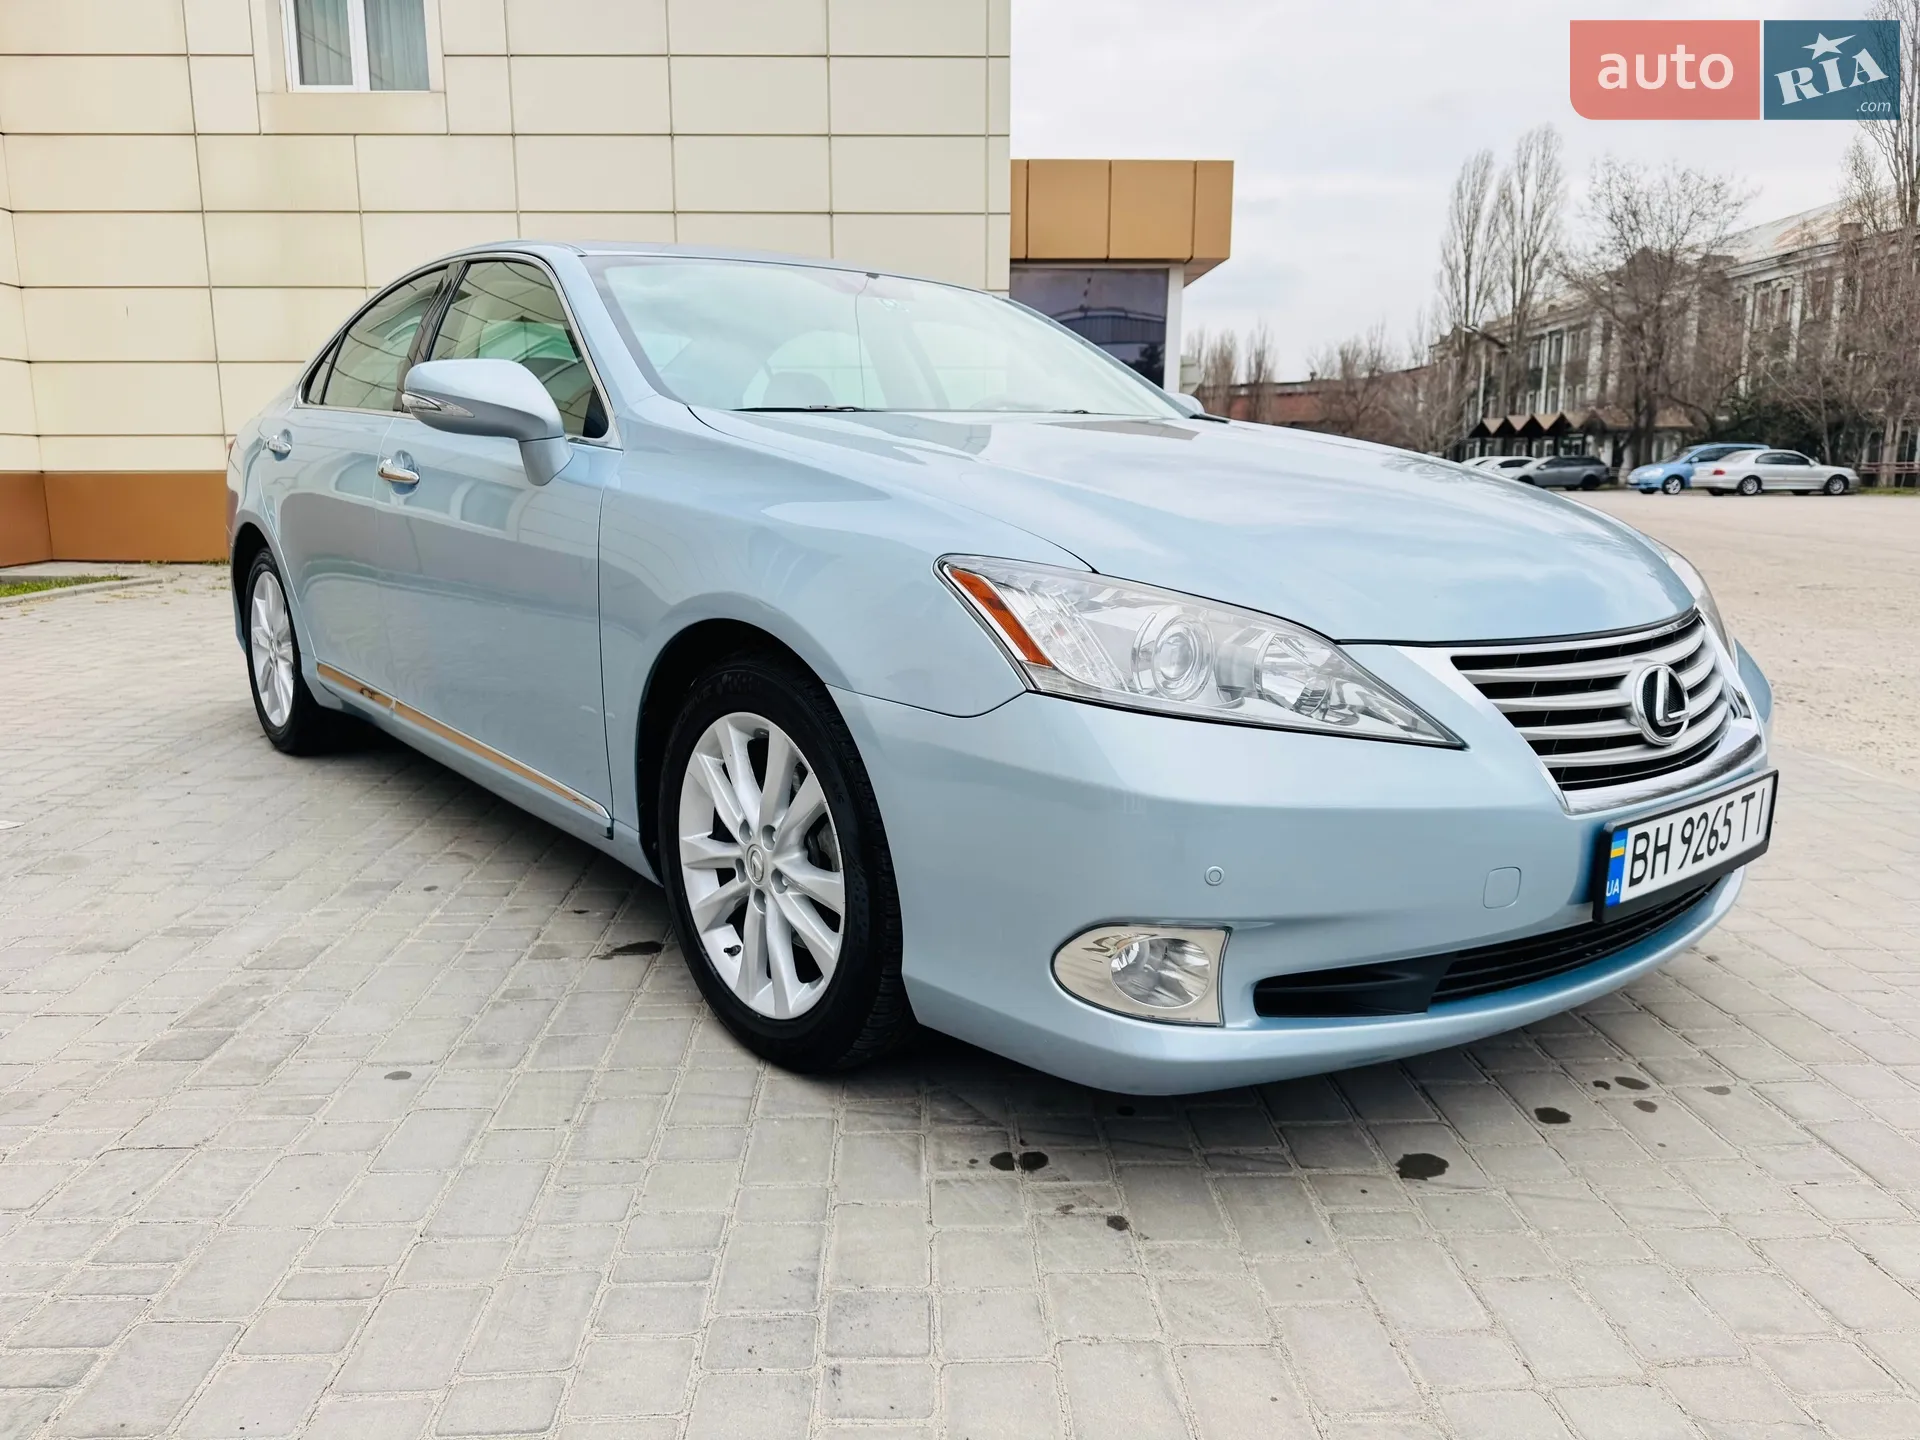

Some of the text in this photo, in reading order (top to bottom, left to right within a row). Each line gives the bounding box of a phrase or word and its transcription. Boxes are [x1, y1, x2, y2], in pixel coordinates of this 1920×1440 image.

[1629, 788, 1766, 888] BH 9265 TI
[1606, 880, 1620, 897] UA
